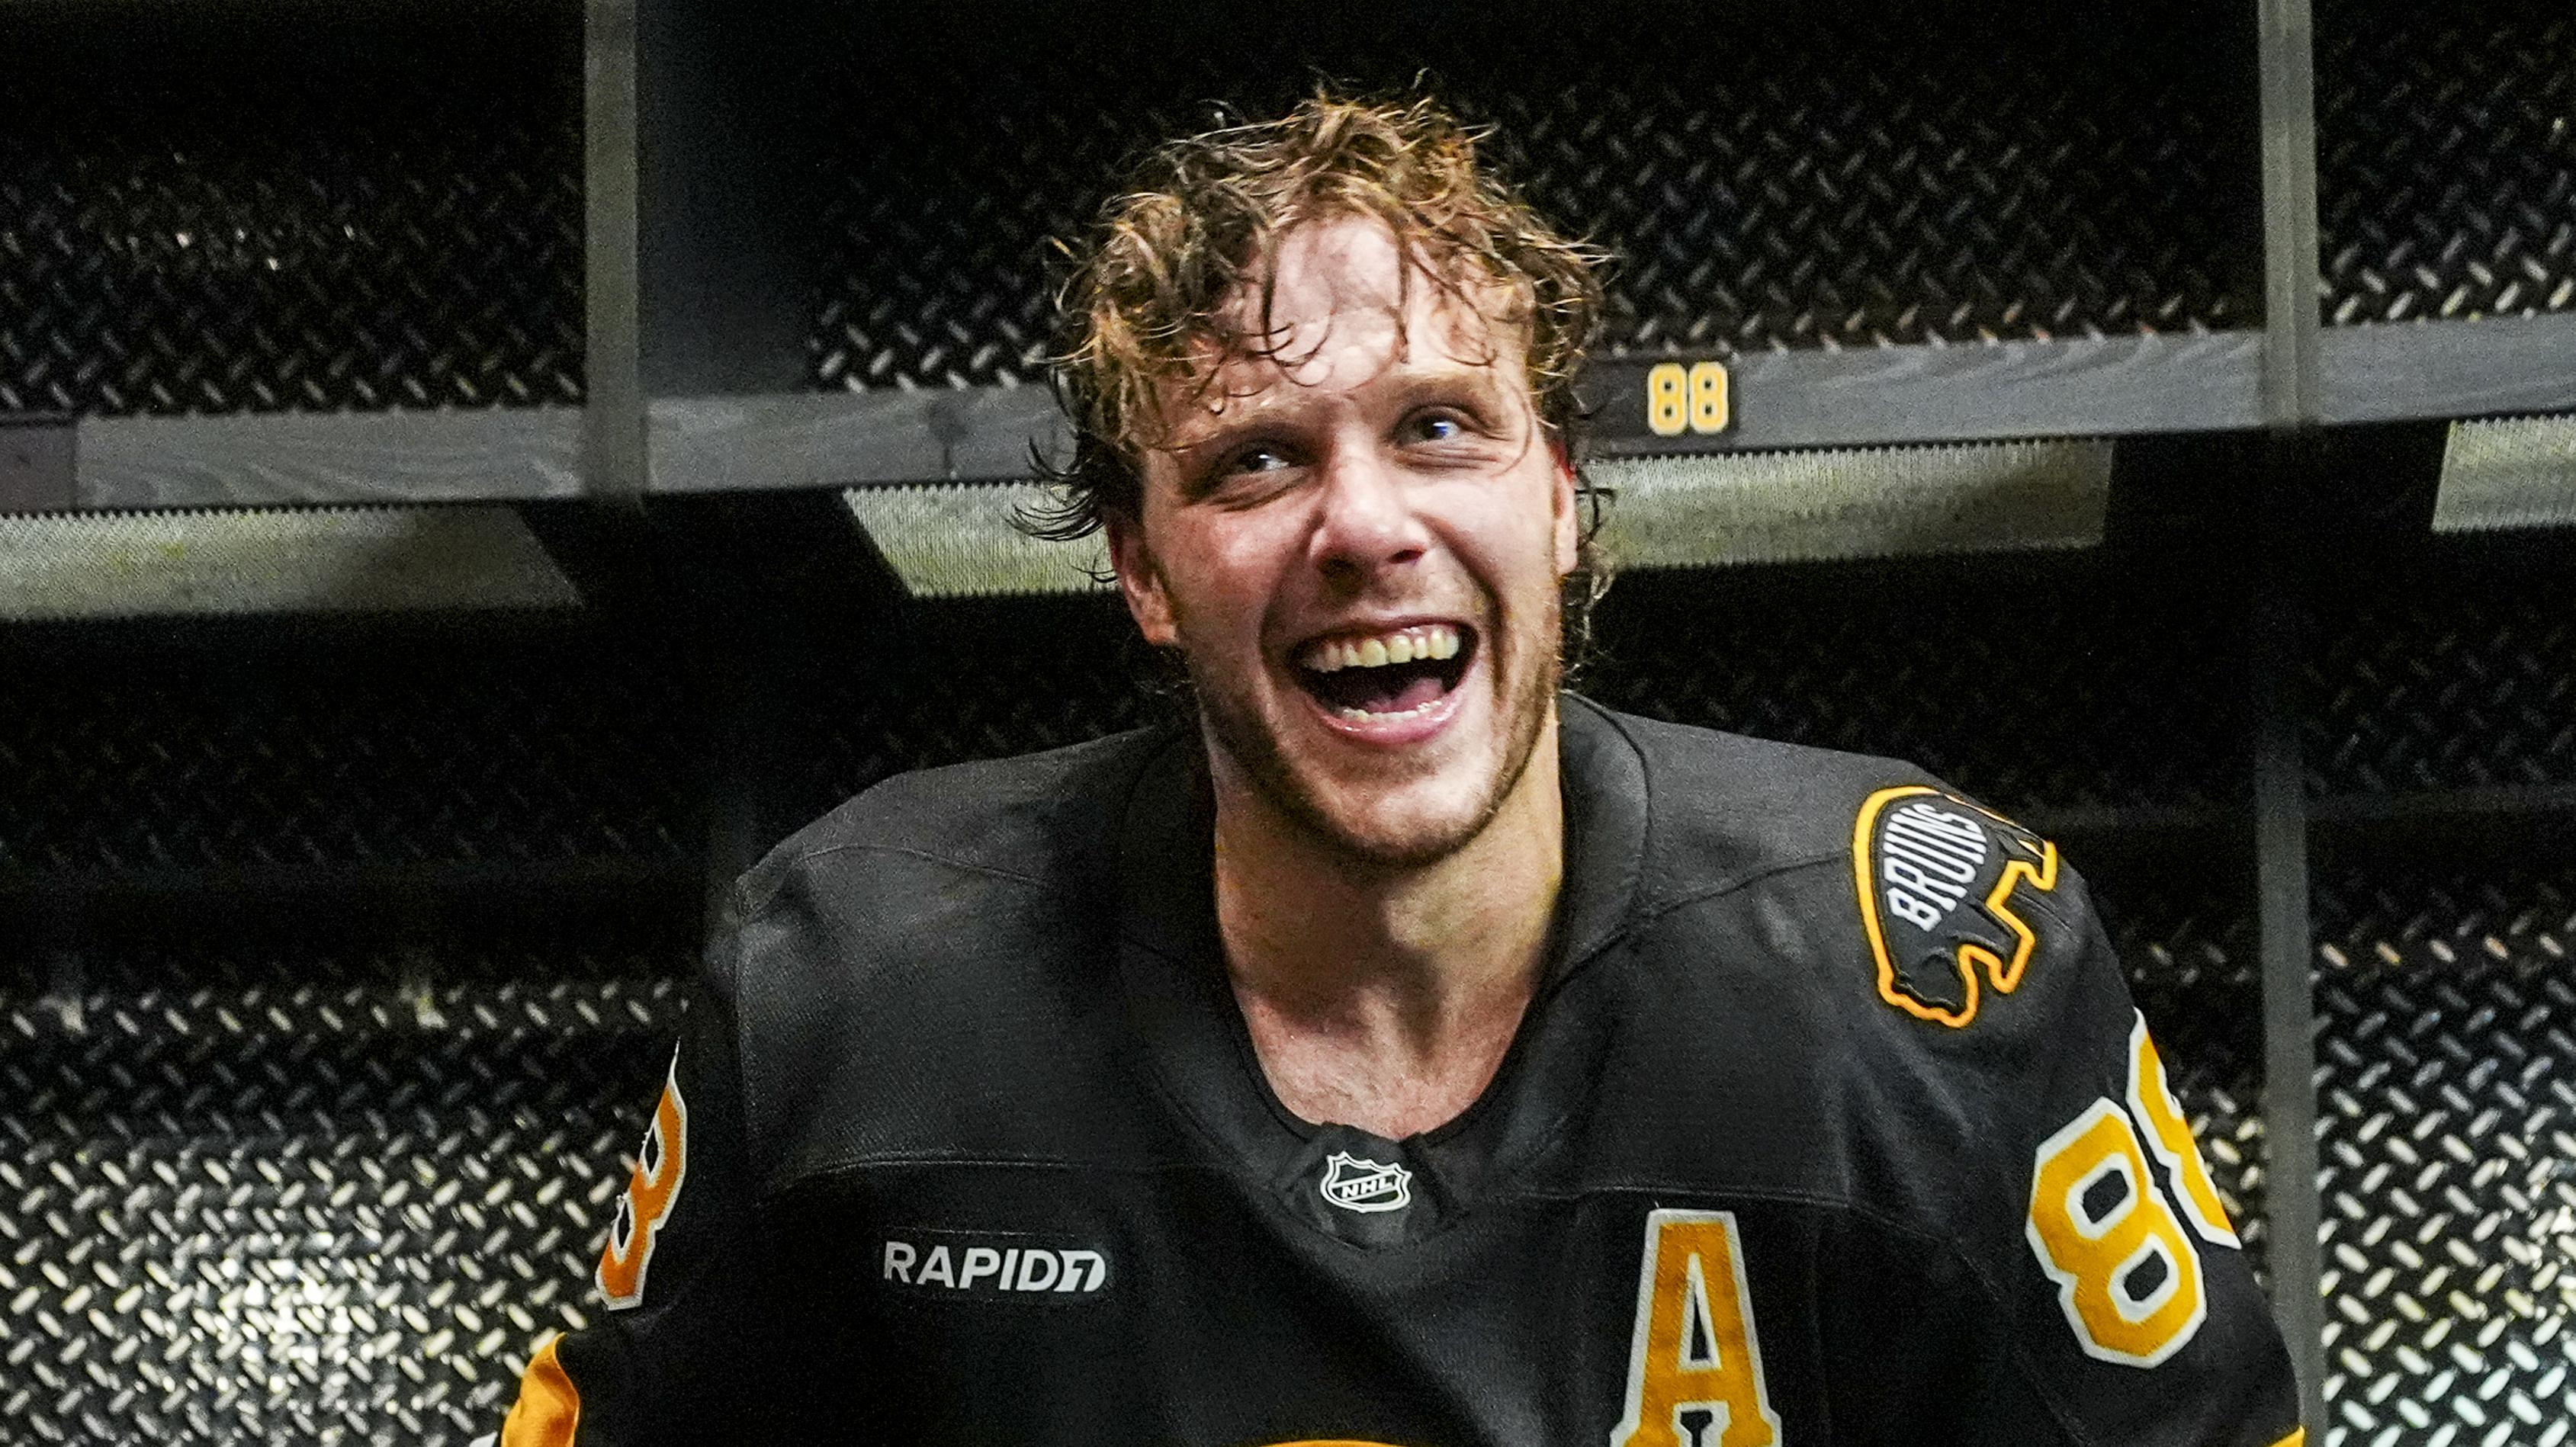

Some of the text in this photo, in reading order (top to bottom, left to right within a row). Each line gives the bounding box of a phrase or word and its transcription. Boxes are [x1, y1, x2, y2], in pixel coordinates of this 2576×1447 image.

[1647, 361, 1729, 436] 88
[1884, 804, 1987, 932] BRUINS
[1341, 1177, 1394, 1198] NHL
[884, 1241, 1106, 1292] RAPID7
[1609, 1208, 1784, 1447] A
